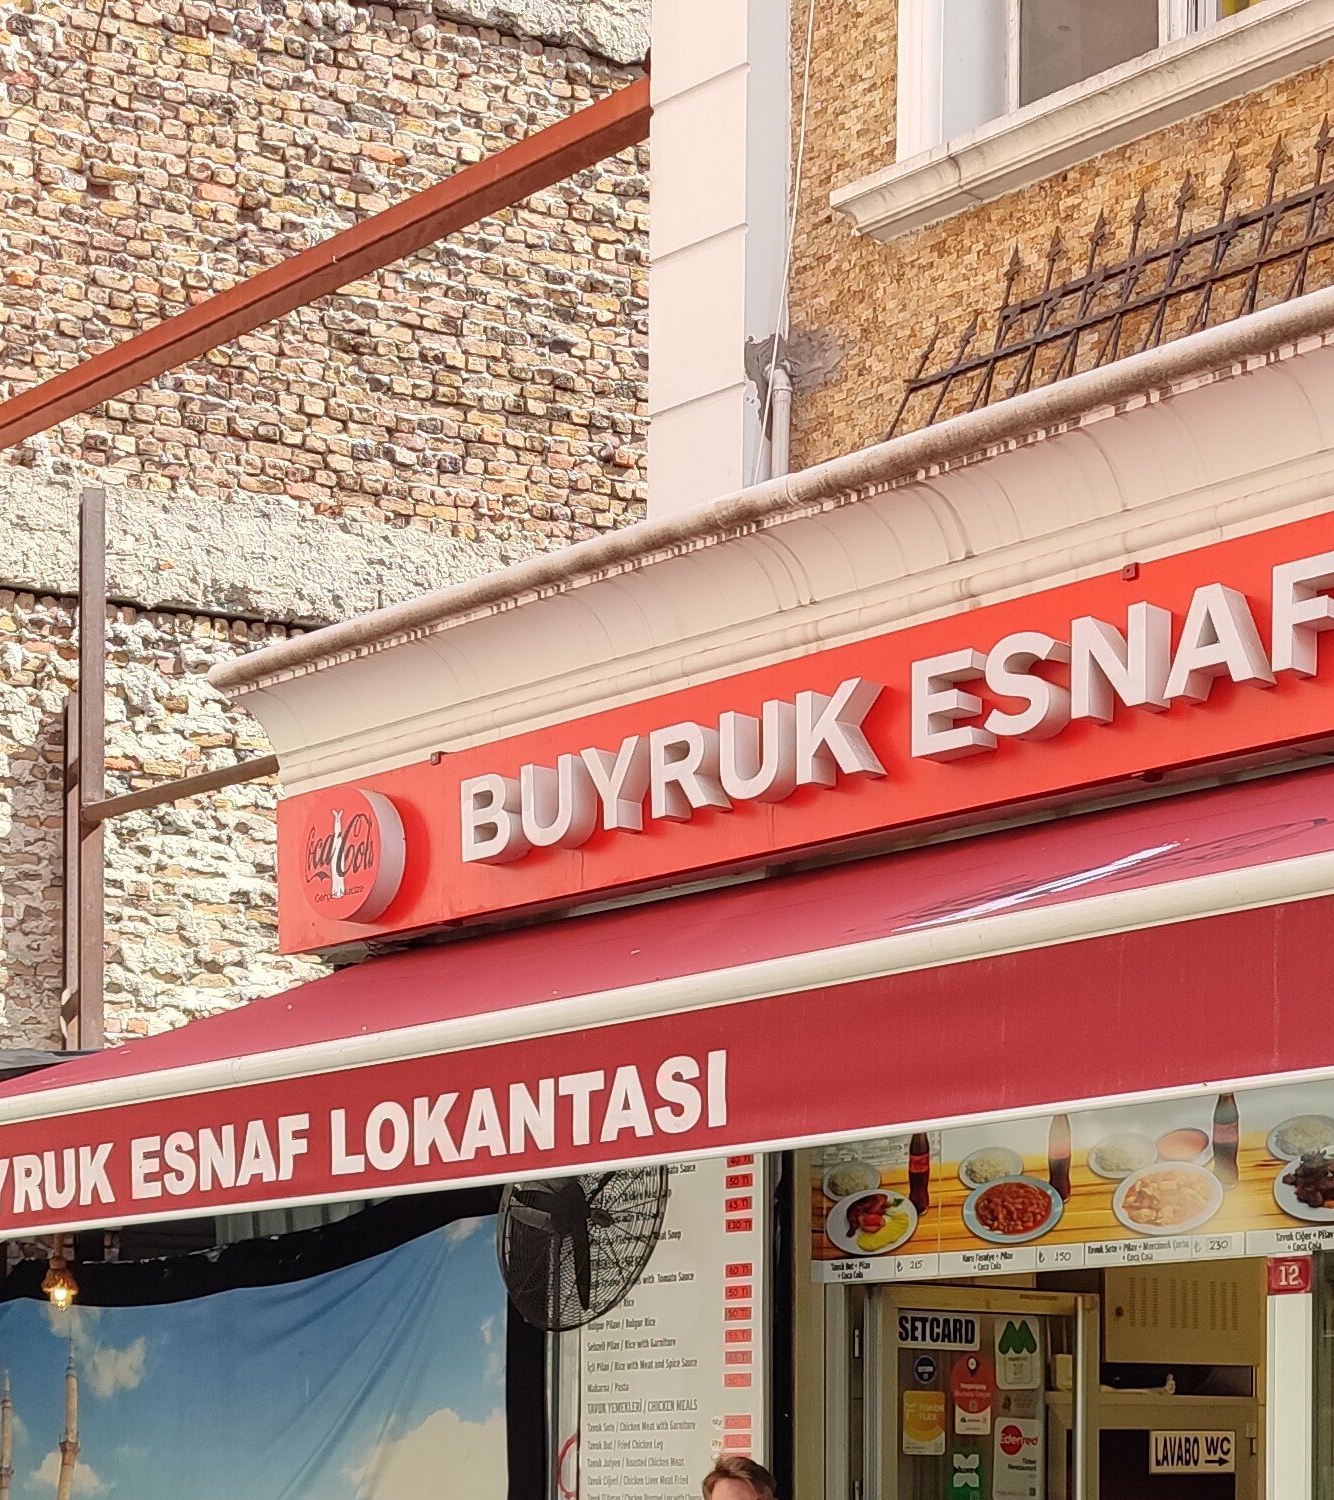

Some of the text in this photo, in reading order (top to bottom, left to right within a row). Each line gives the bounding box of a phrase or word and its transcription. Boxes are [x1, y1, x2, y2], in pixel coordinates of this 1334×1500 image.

[459, 676, 887, 864] BUYRUK
[131, 1111, 313, 1199] ESNAF
[331, 1049, 729, 1178] LOKANTASI
[1054, 1251, 1071, 1262] 150
[1209, 1239, 1228, 1251] 230
[1292, 1241, 1322, 1251] Coca Cola
[1279, 1265, 1300, 1286] 12
[898, 1315, 976, 1345] SETCARD
[1154, 1436, 1232, 1467] LAVABO WC
